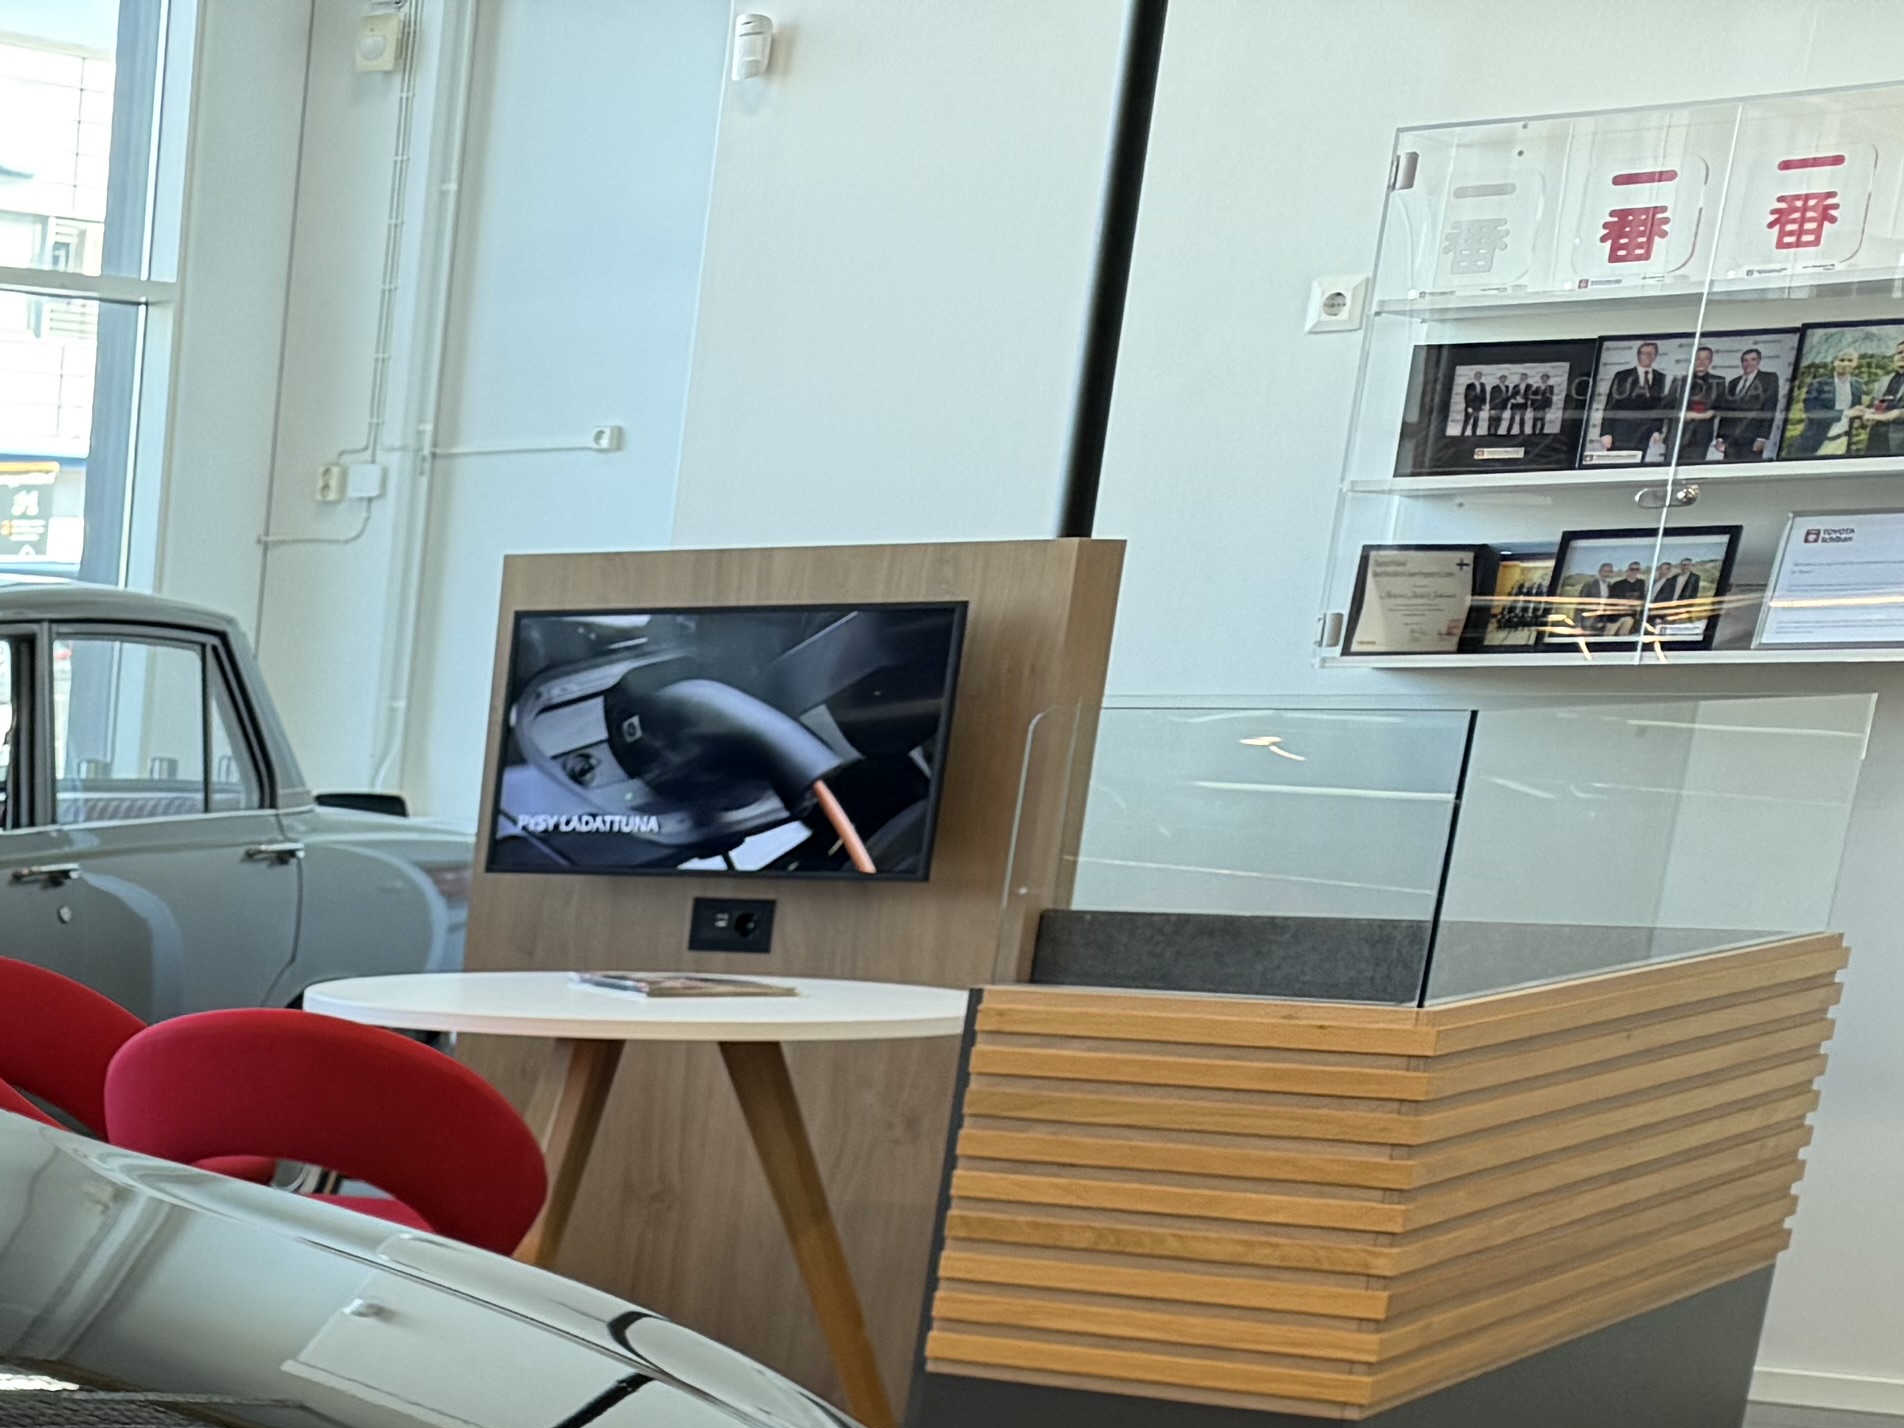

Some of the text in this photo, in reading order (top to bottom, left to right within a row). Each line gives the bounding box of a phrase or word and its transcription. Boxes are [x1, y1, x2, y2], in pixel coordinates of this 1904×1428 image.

[1599, 169, 1679, 264] 一番
[1766, 154, 1847, 250] 一番
[516, 813, 660, 833] PYSY LADATTUNA
